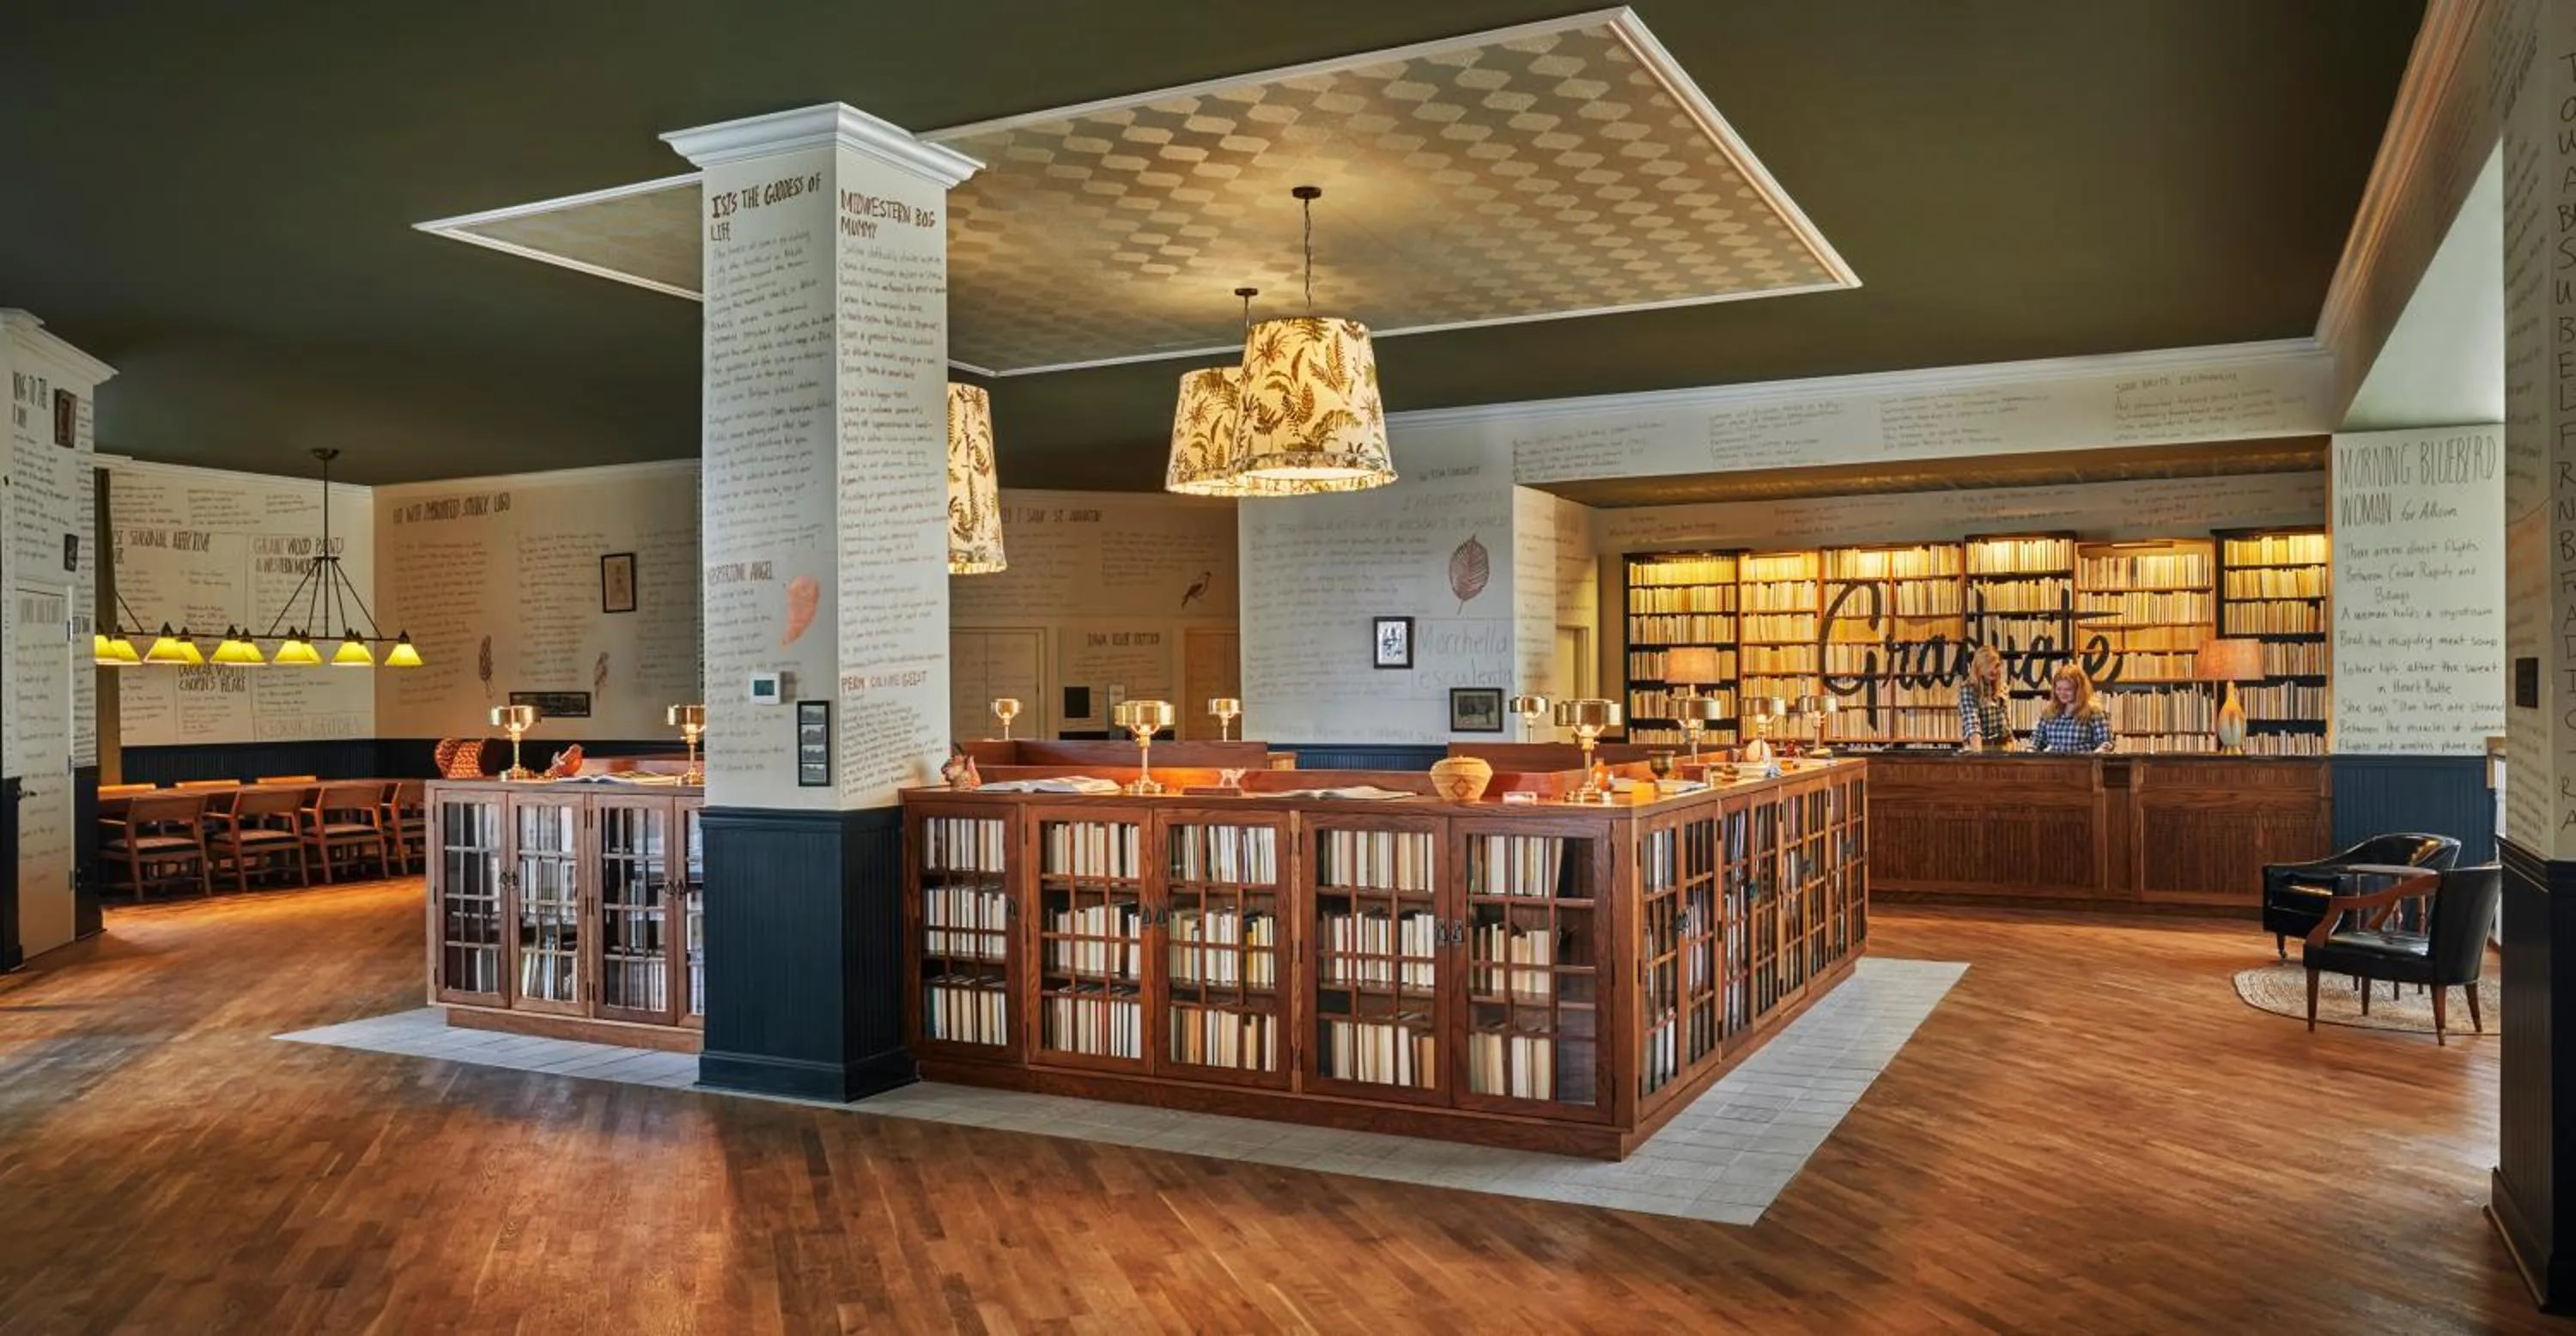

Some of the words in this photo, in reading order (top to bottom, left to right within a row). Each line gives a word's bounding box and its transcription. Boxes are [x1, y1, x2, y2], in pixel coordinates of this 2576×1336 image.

[742, 185, 759, 209] THE
[763, 176, 804, 206] GODDESS
[807, 172, 821, 193] OF
[841, 188, 911, 223] MIDWESTERN
[915, 208, 936, 228] BOG
[711, 222, 731, 241] LIFE
[2340, 442, 2411, 489] MORNING
[2419, 435, 2496, 486] BLUEBIRD
[2341, 491, 2392, 528] WOMAN
[1819, 579, 2127, 732] Graduate
